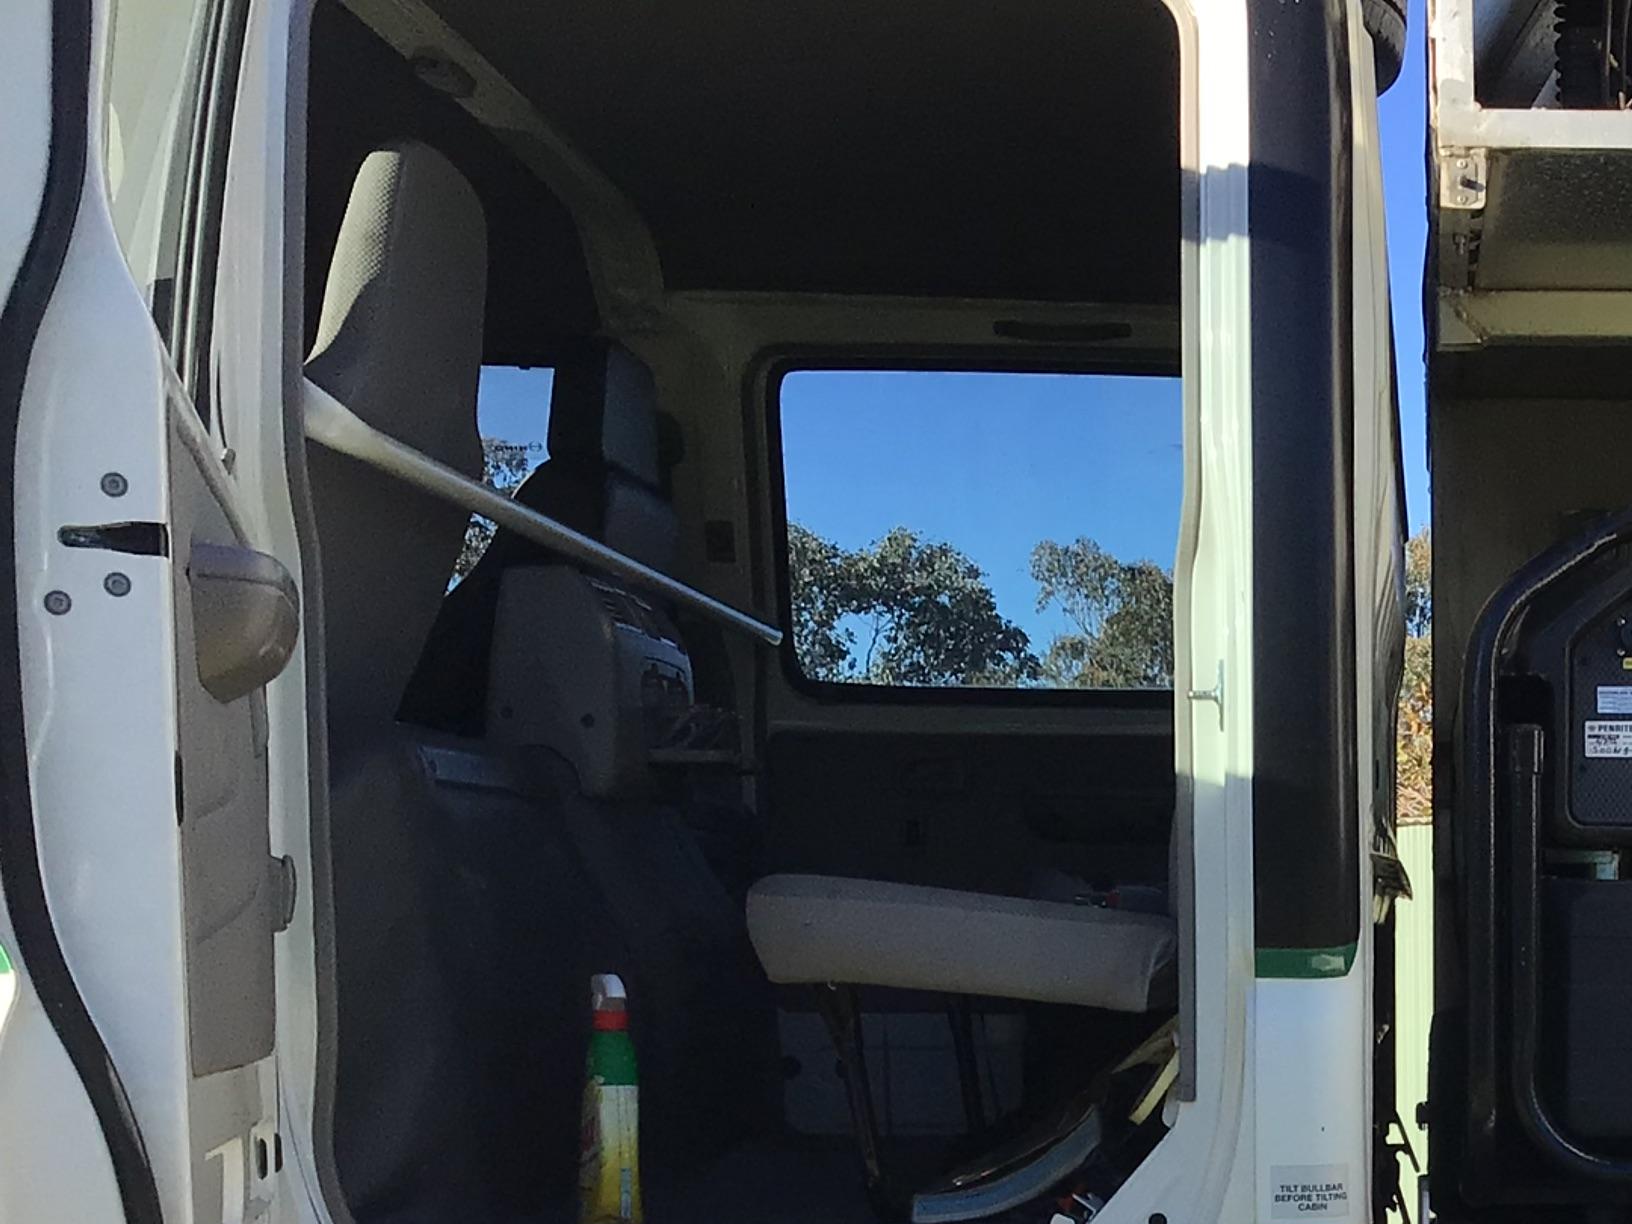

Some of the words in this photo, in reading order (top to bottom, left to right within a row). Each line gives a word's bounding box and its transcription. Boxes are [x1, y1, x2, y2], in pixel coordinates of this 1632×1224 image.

[1598, 724, 1632, 732] PENRITE
[1280, 1184, 1298, 1192] TILT
[1301, 1183, 1343, 1192] BULLBAR
[1274, 1194, 1312, 1202] BEFORE
[1316, 1192, 1347, 1201] TILTING
[1297, 1203, 1328, 1211] CABIN
